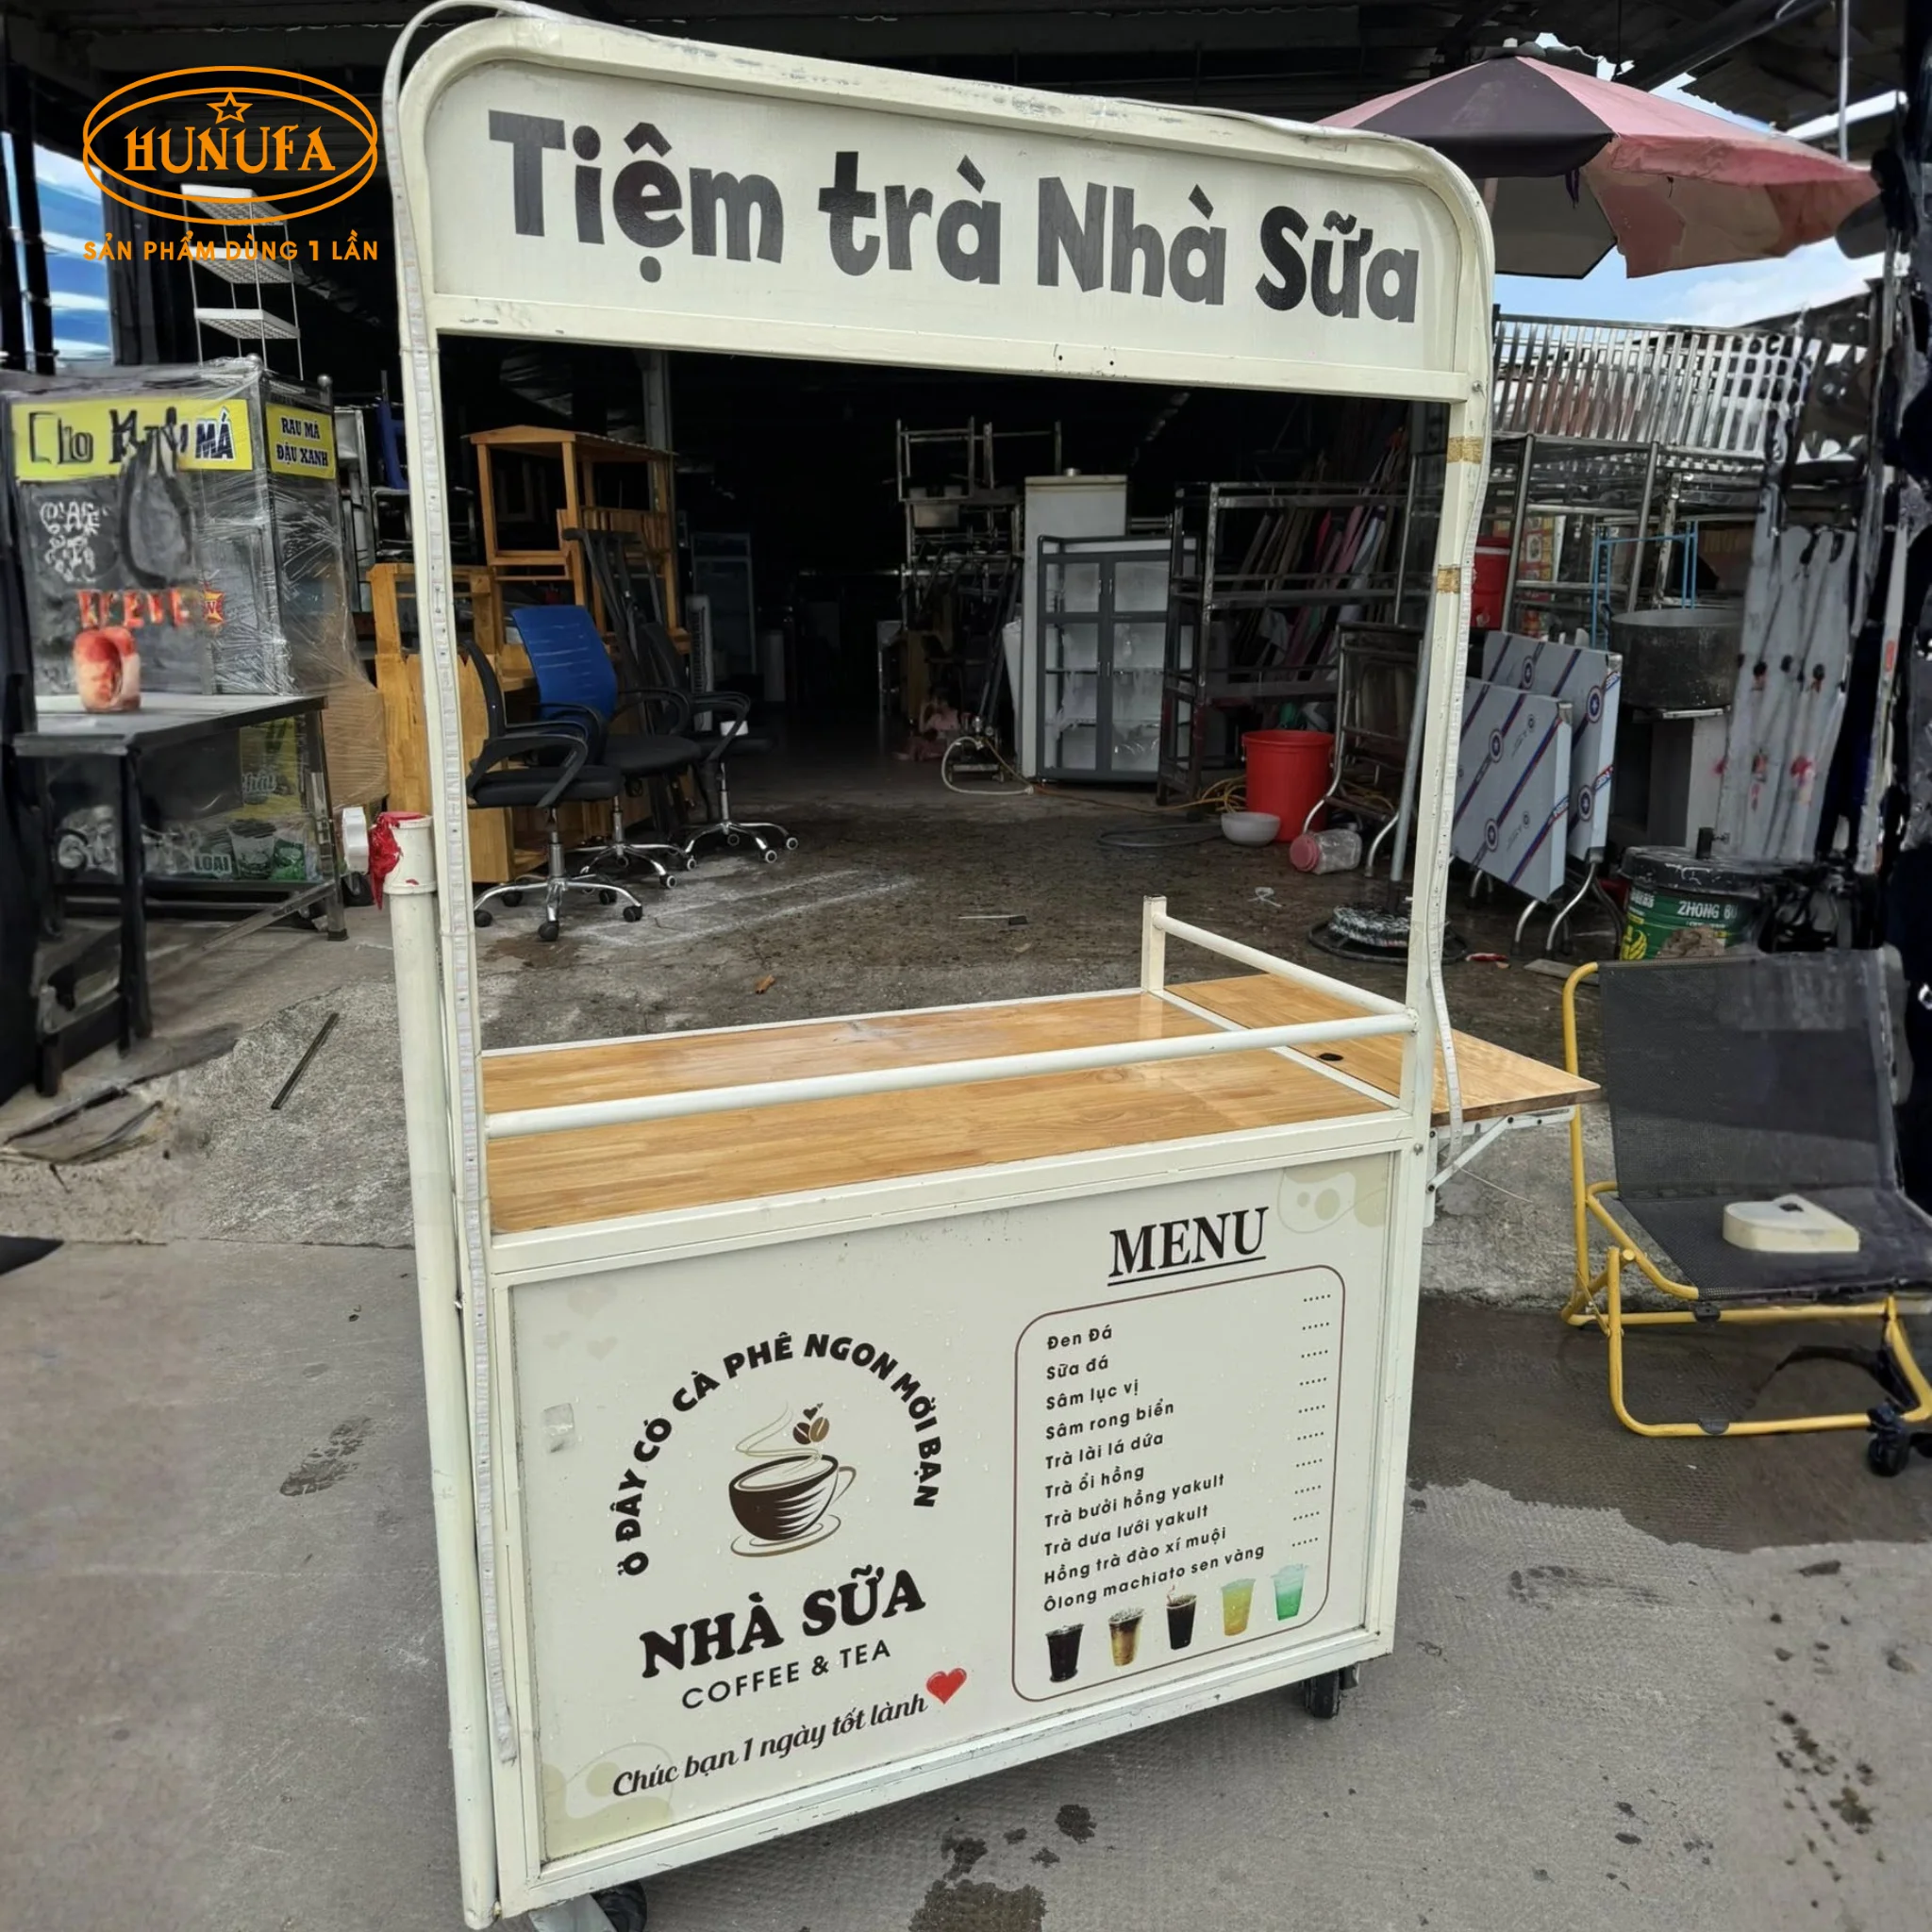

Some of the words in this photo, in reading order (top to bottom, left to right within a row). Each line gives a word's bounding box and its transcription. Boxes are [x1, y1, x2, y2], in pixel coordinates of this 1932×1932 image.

[489, 110, 783, 282] Tiệm
[818, 151, 1000, 284] trà
[1038, 177, 1226, 305] Nhà
[1256, 206, 1419, 323] Sữa
[281, 417, 302, 436] RAU
[304, 420, 321, 440] MÁ
[300, 448, 329, 467] XANH
[1108, 1206, 1269, 1277] MENU
[1047, 1334, 1081, 1350] Đen
[1089, 1324, 1111, 1341] Đá
[1047, 1364, 1078, 1379] Sữa
[1086, 1355, 1108, 1372] đá
[1046, 1424, 1083, 1440] Sâm
[1091, 1413, 1129, 1430] rong
[1137, 1398, 1173, 1420] biển
[1047, 1393, 1083, 1409] Sâm
[1091, 1387, 1116, 1403] lục
[1124, 1379, 1138, 1395] vị
[610, 1469, 646, 1542] ĐÂY
[673, 1371, 720, 1411] CÀ
[724, 1332, 792, 1379] PHÊ
[804, 1334, 898, 1380] NGON
[913, 1437, 941, 1507] BẠN
[1046, 1452, 1072, 1469] Trà
[1080, 1445, 1101, 1461] lài
[1108, 1440, 1124, 1455] lá
[1131, 1433, 1162, 1450] dứa
[1045, 1481, 1072, 1498] Trà
[1079, 1473, 1093, 1491] ổi
[1102, 1466, 1143, 1485] hồng
[1045, 1509, 1071, 1527] Trà
[1079, 1499, 1116, 1519] bưởi
[1124, 1490, 1165, 1508] hồng
[1173, 1474, 1224, 1499] yakult
[1044, 1539, 1071, 1556] Trà
[1078, 1532, 1110, 1547] dưa
[1118, 1519, 1149, 1538] lưới
[1156, 1505, 1208, 1531] yakult
[1045, 1564, 1090, 1584] Hồng
[1096, 1554, 1120, 1571] trà
[1127, 1547, 1158, 1563] đào
[1166, 1538, 1180, 1553] xí
[1187, 1527, 1224, 1548] muội
[1044, 1591, 1096, 1611] Ôlong
[1103, 1567, 1186, 1597] machiato
[1191, 1558, 1218, 1574] sen
[1225, 1546, 1263, 1564] vàng
[640, 1591, 784, 1678] NHÀ
[803, 1564, 925, 1636] SỮA
[682, 1662, 799, 1708] COFFEE
[811, 1656, 828, 1675] &
[840, 1640, 891, 1668] TEA
[613, 1765, 678, 1796] Chúc
[685, 1751, 739, 1778] bạn
[744, 1738, 753, 1761] 1
[760, 1724, 825, 1758] ngày
[832, 1707, 864, 1736] tốt
[871, 1694, 927, 1725] lành
